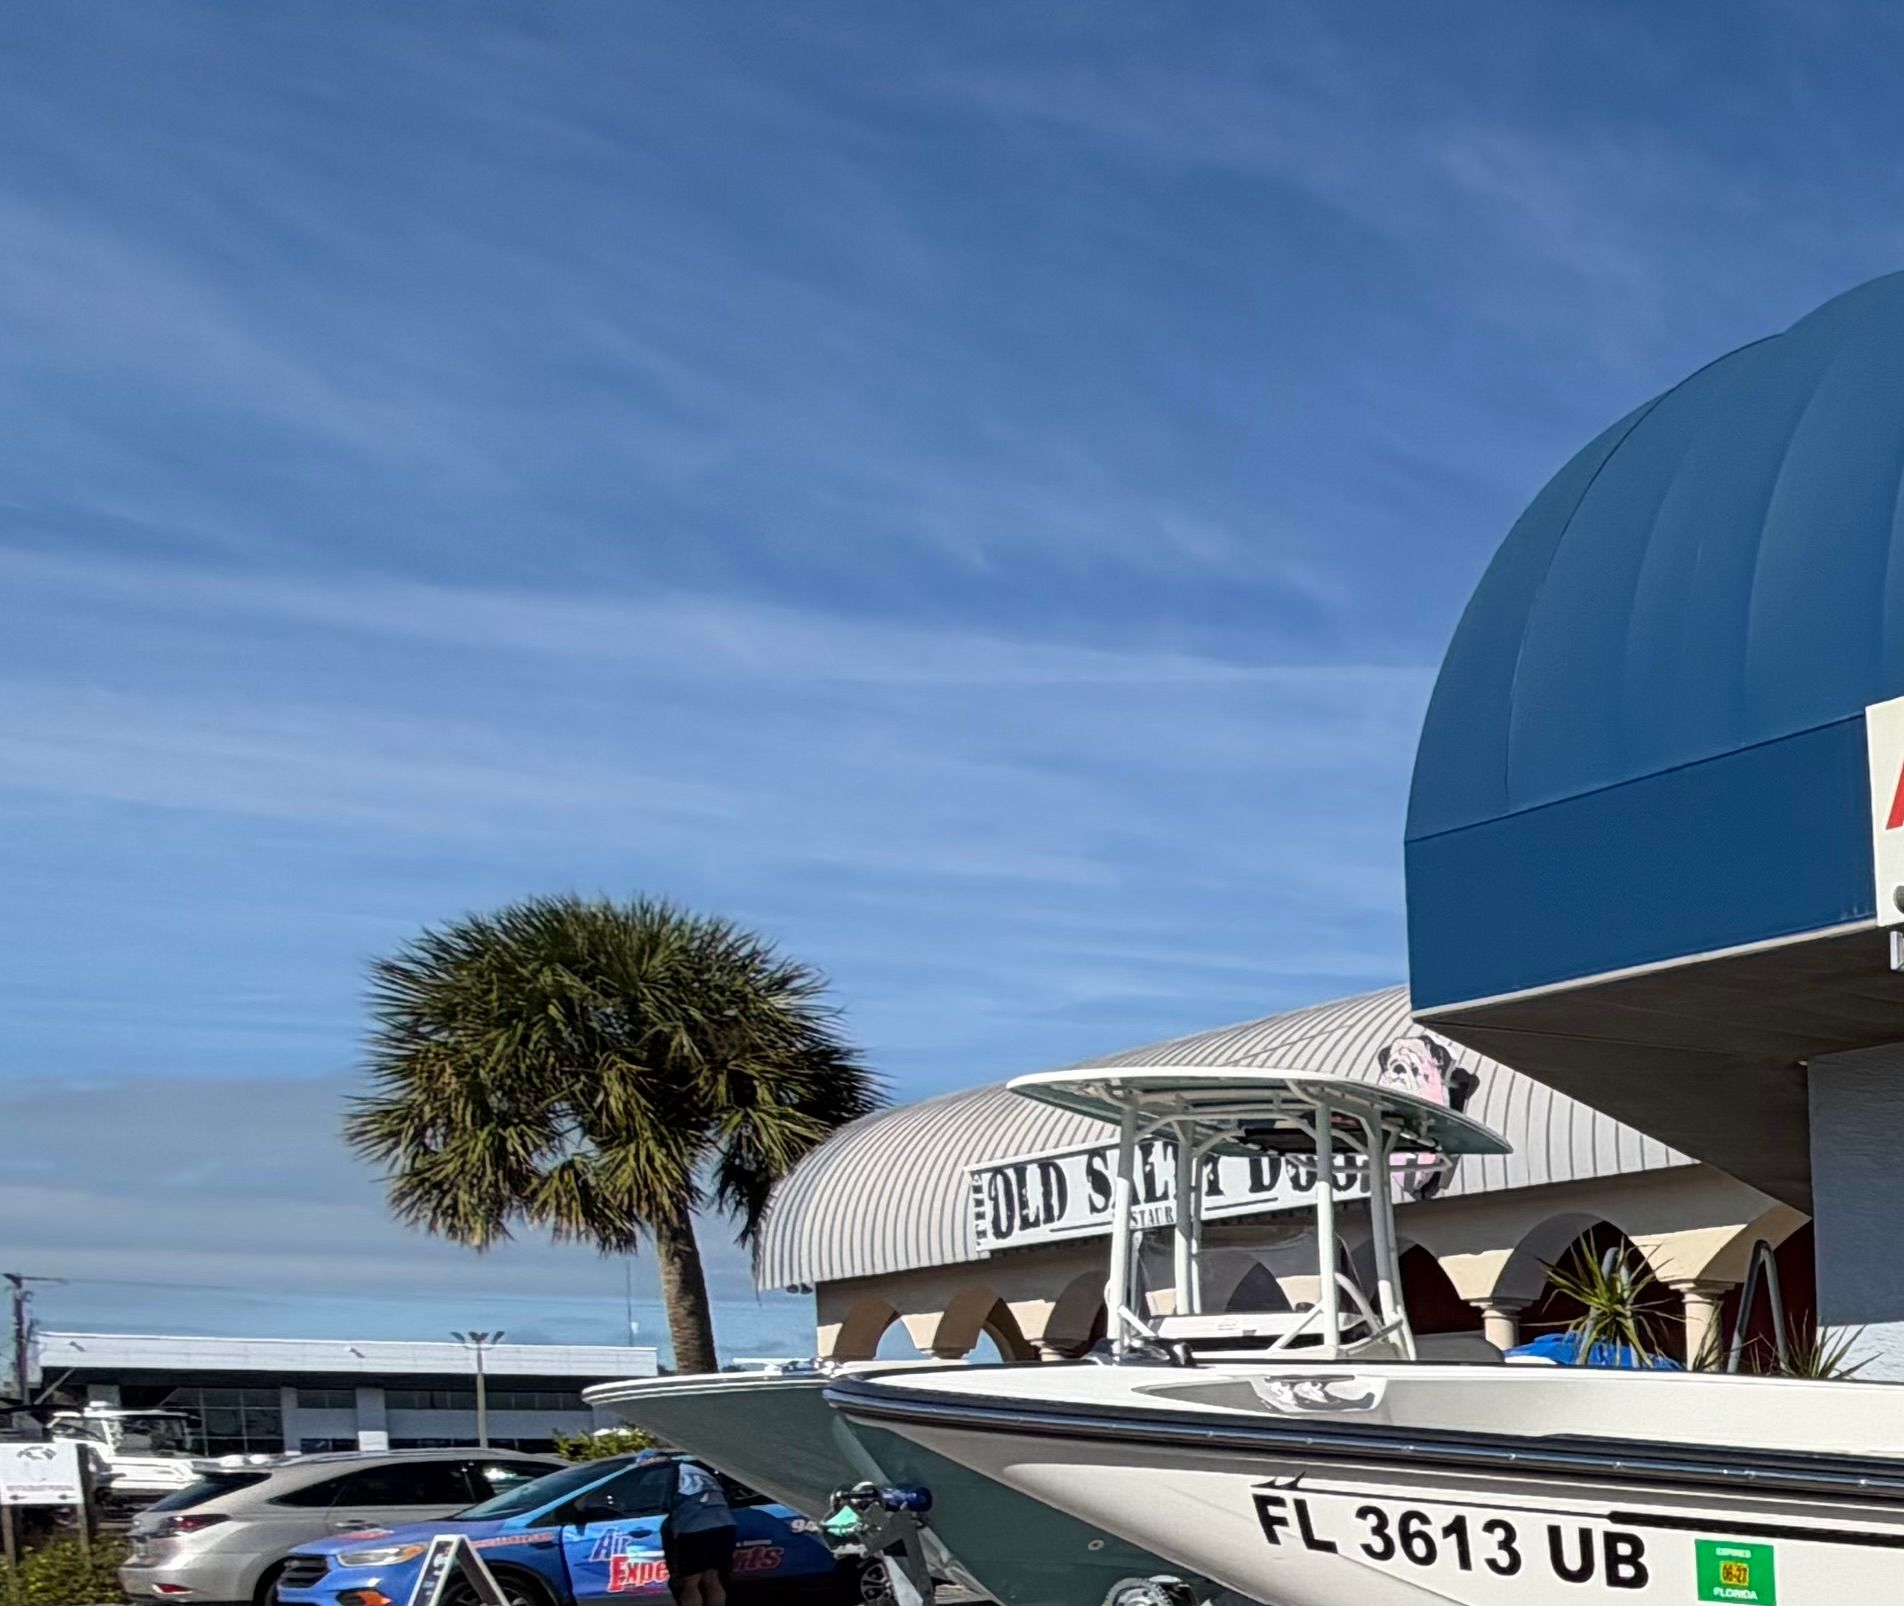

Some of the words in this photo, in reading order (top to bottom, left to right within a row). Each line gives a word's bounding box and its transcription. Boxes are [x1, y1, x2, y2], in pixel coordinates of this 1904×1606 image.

[988, 1162, 1068, 1240] OLD
[589, 1527, 631, 1562] Air
[1252, 1494, 1338, 1554] FL
[1355, 1505, 1522, 1577] 3613
[1547, 1525, 1650, 1590] UB
[1713, 1587, 1758, 1600] FLORIDA
